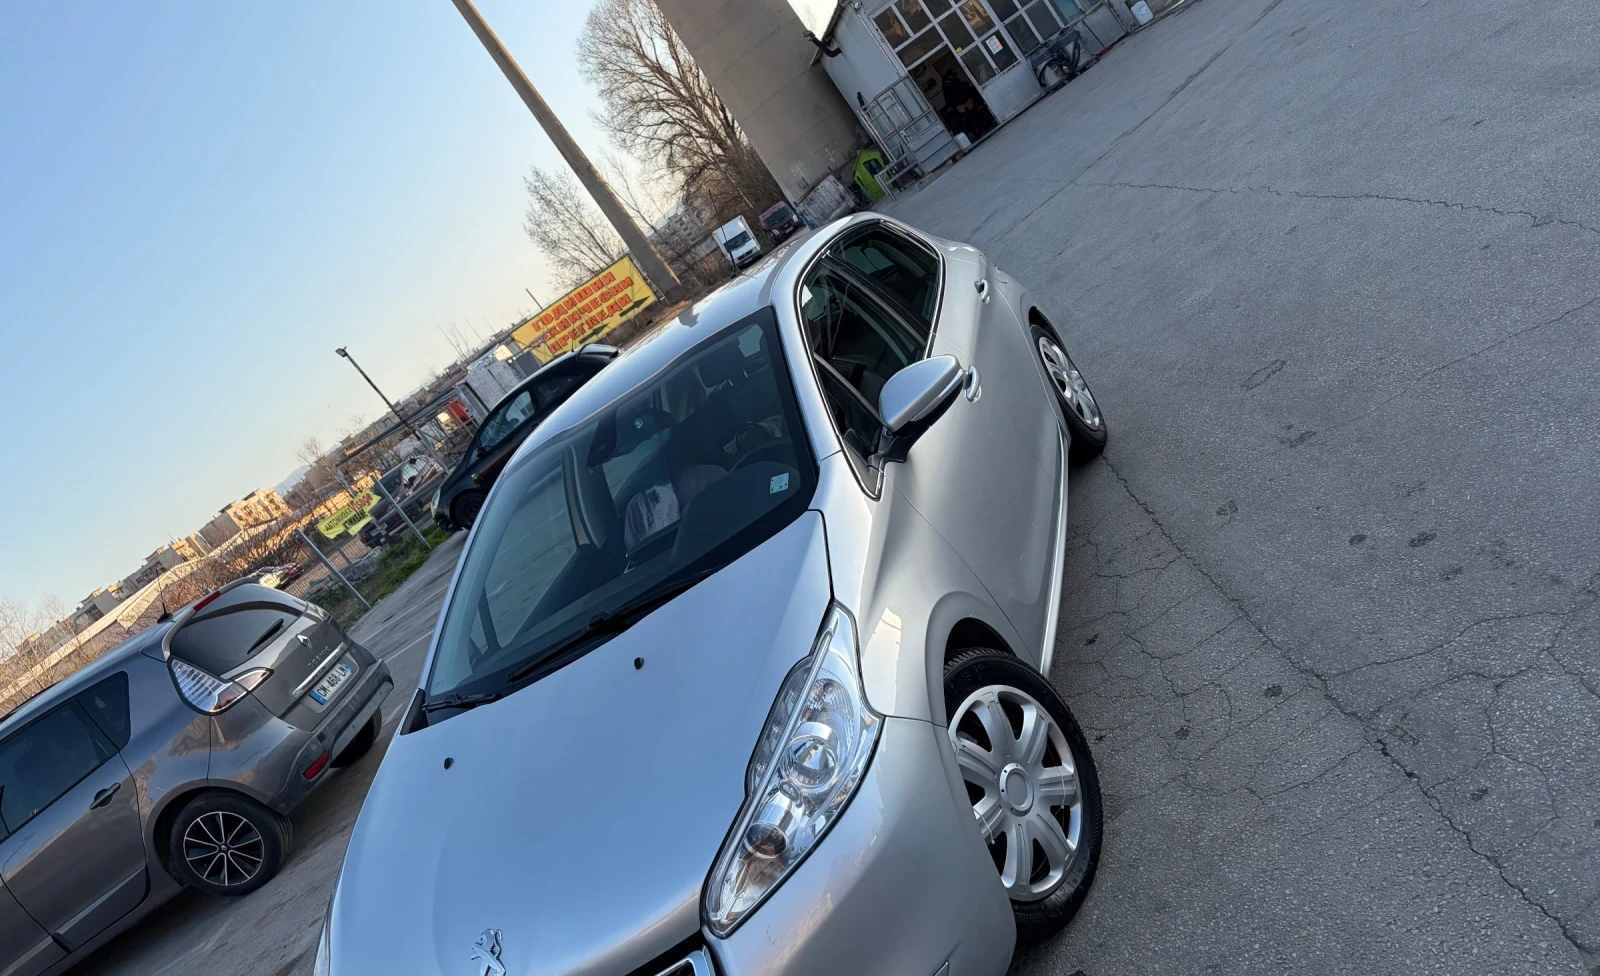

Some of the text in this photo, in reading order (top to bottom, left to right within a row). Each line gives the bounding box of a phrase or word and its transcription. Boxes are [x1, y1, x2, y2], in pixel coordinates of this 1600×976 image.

[531, 271, 616, 332] ГОДИШНИ
[547, 293, 632, 354] ПРЕГЛЕДИ
[317, 666, 348, 697] CM-468-LM
